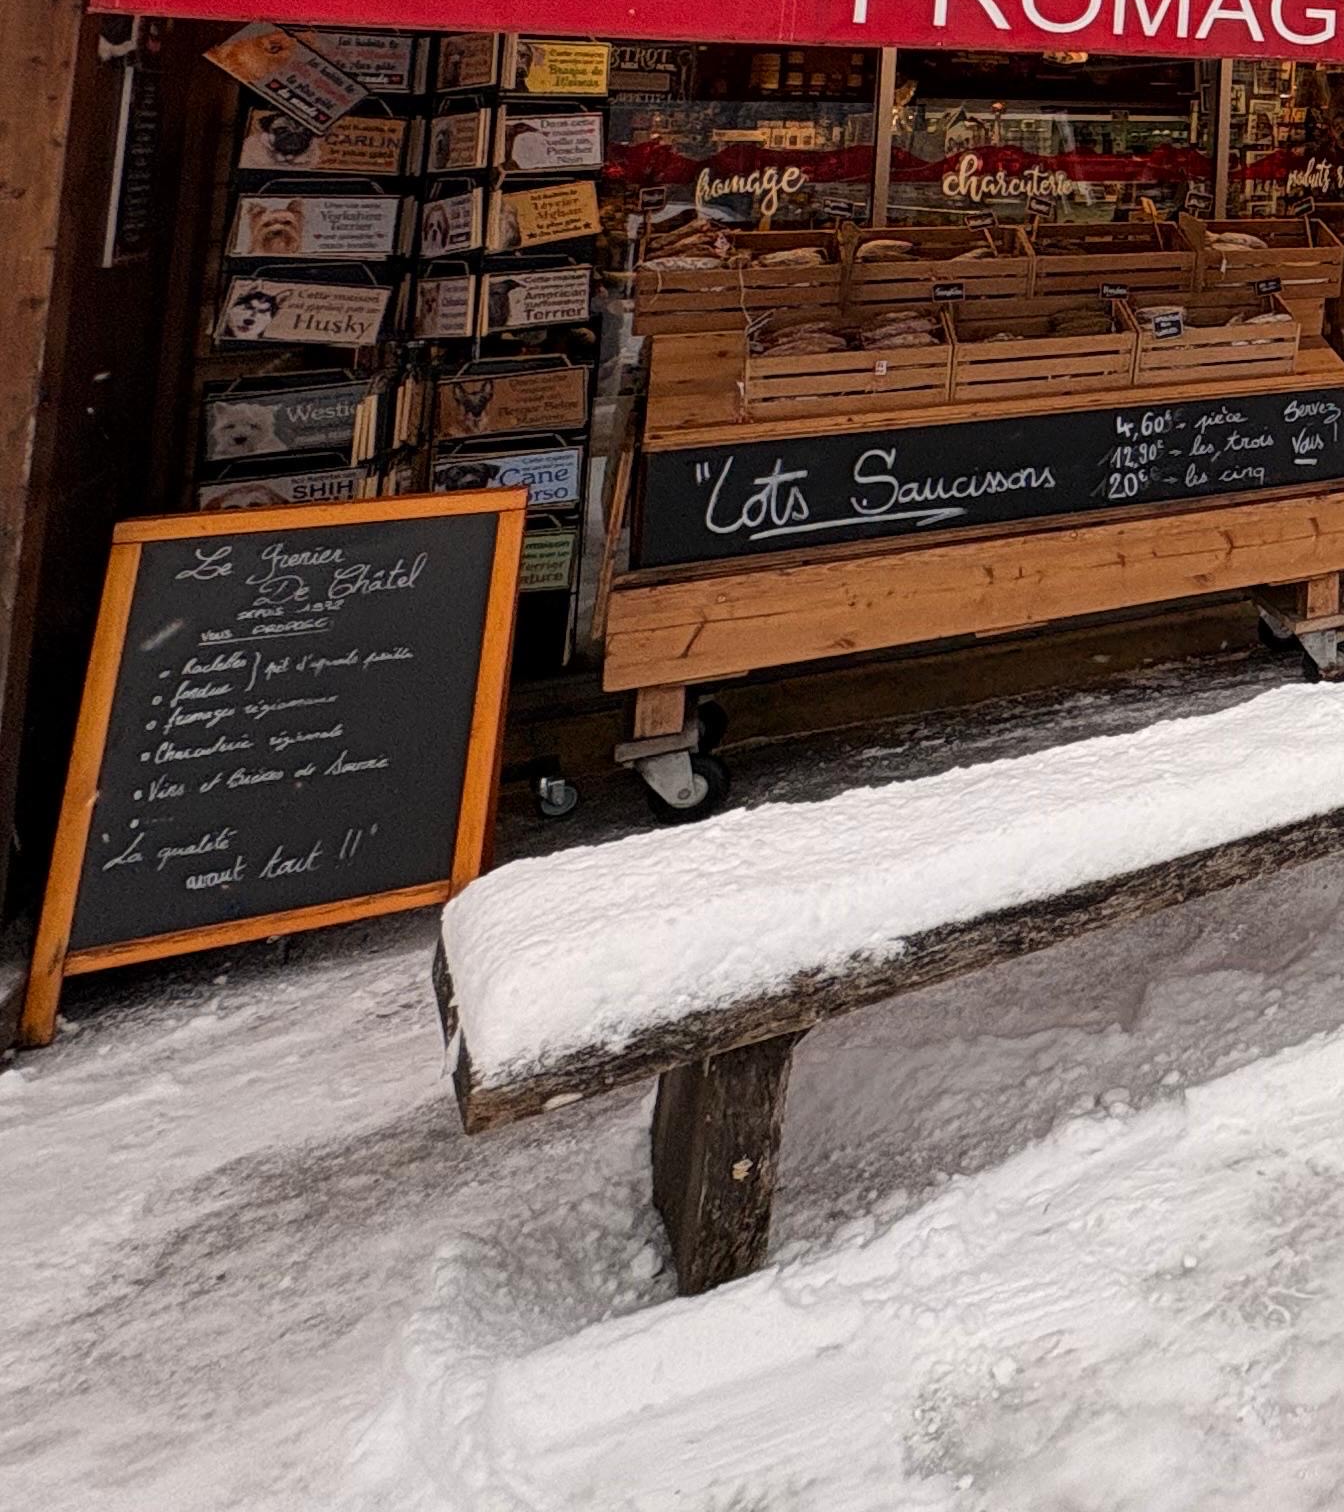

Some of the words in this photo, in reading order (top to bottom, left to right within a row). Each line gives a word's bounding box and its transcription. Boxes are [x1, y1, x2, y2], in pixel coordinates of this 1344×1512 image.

[695, 166, 809, 218] fromage
[943, 154, 1073, 202] charcuterie
[293, 313, 374, 339] Husky
[293, 480, 353, 500] SHIH
[500, 467, 570, 488] Cane
[527, 486, 569, 503] rso
[849, 446, 1056, 516] Saucissons
[175, 544, 234, 580] Le
[245, 542, 346, 586] Grenier
[328, 551, 428, 600] Châtel
